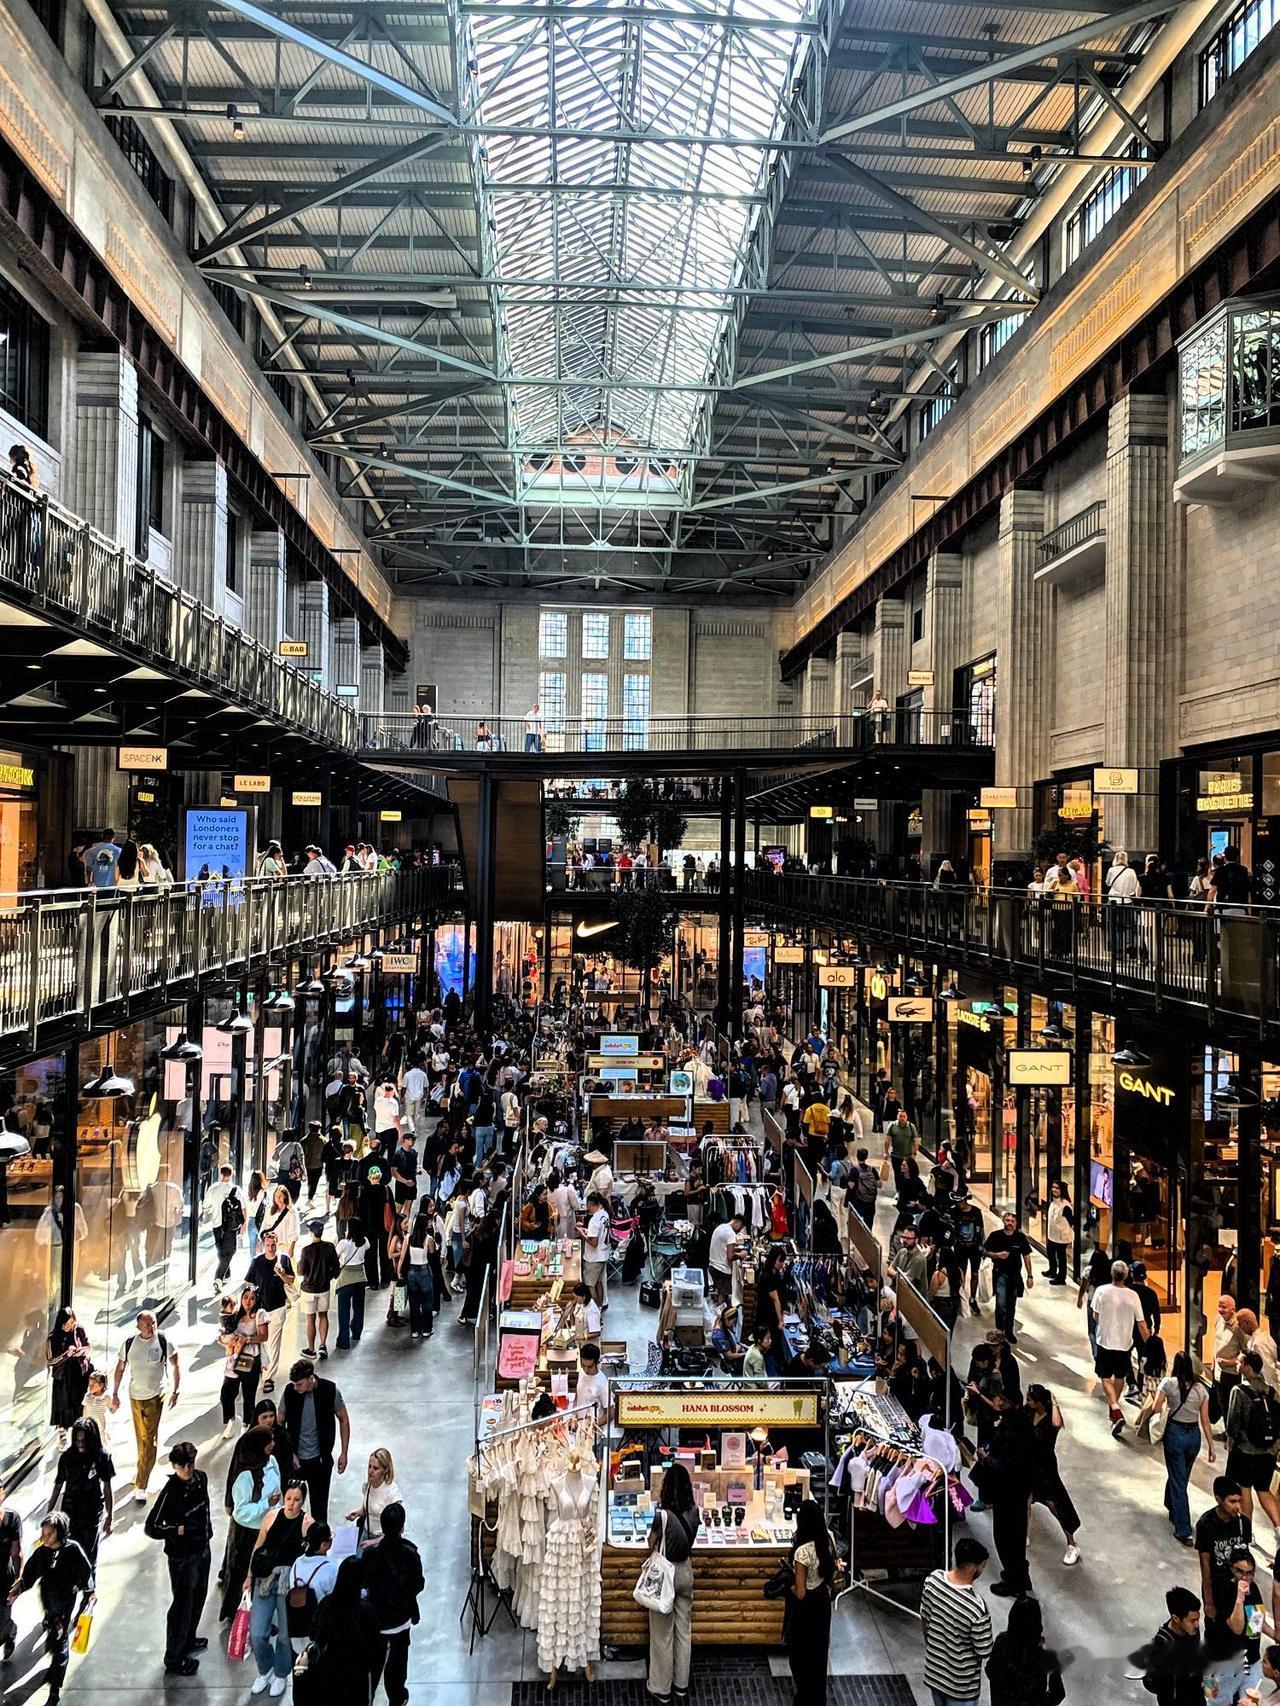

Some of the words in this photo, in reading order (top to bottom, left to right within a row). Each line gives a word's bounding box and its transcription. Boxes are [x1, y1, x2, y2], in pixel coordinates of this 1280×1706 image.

[219, 834, 240, 842] stop
[193, 842, 207, 850] for
[390, 956, 410, 965] IWC
[827, 970, 846, 983] alo
[1015, 1064, 1064, 1072] GANT
[1119, 1072, 1175, 1106] GANT
[682, 1404, 708, 1413] HANA
[710, 1404, 754, 1413] BLOSSOM
